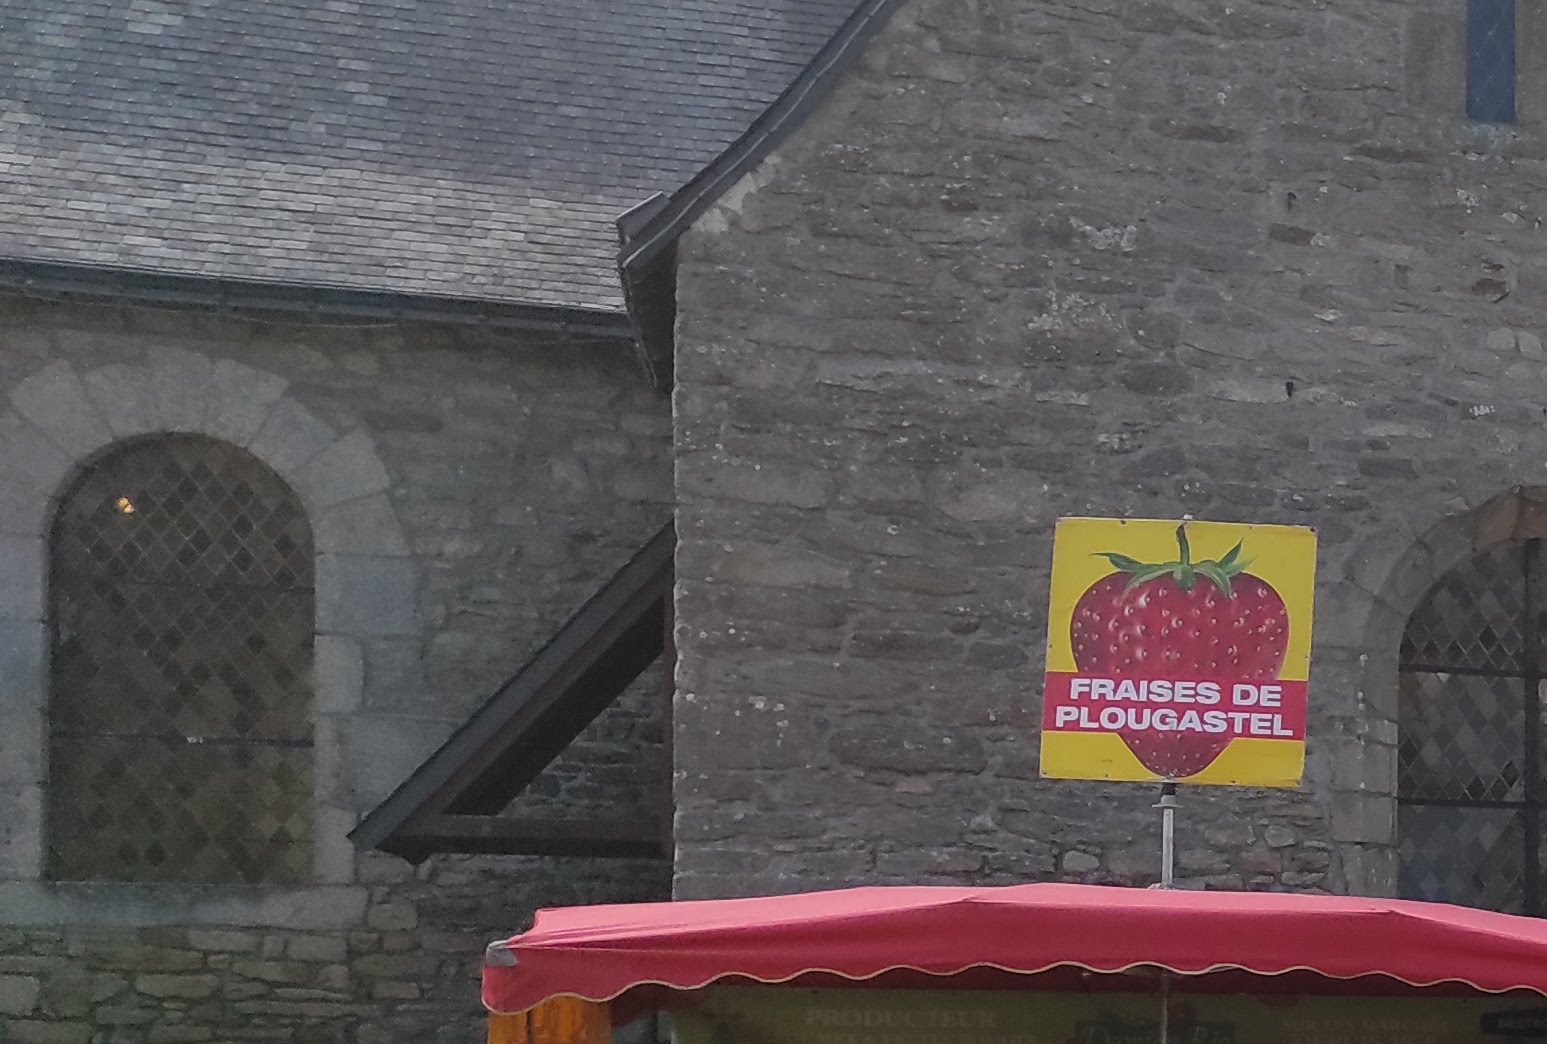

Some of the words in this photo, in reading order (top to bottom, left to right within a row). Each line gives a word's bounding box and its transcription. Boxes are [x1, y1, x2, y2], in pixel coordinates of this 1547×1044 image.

[1070, 678, 1221, 705] FRAISES
[1233, 684, 1282, 707] DE
[1055, 706, 1293, 736] PLOUGASTEL
[805, 1008, 997, 1029] PRODUCTEUR
